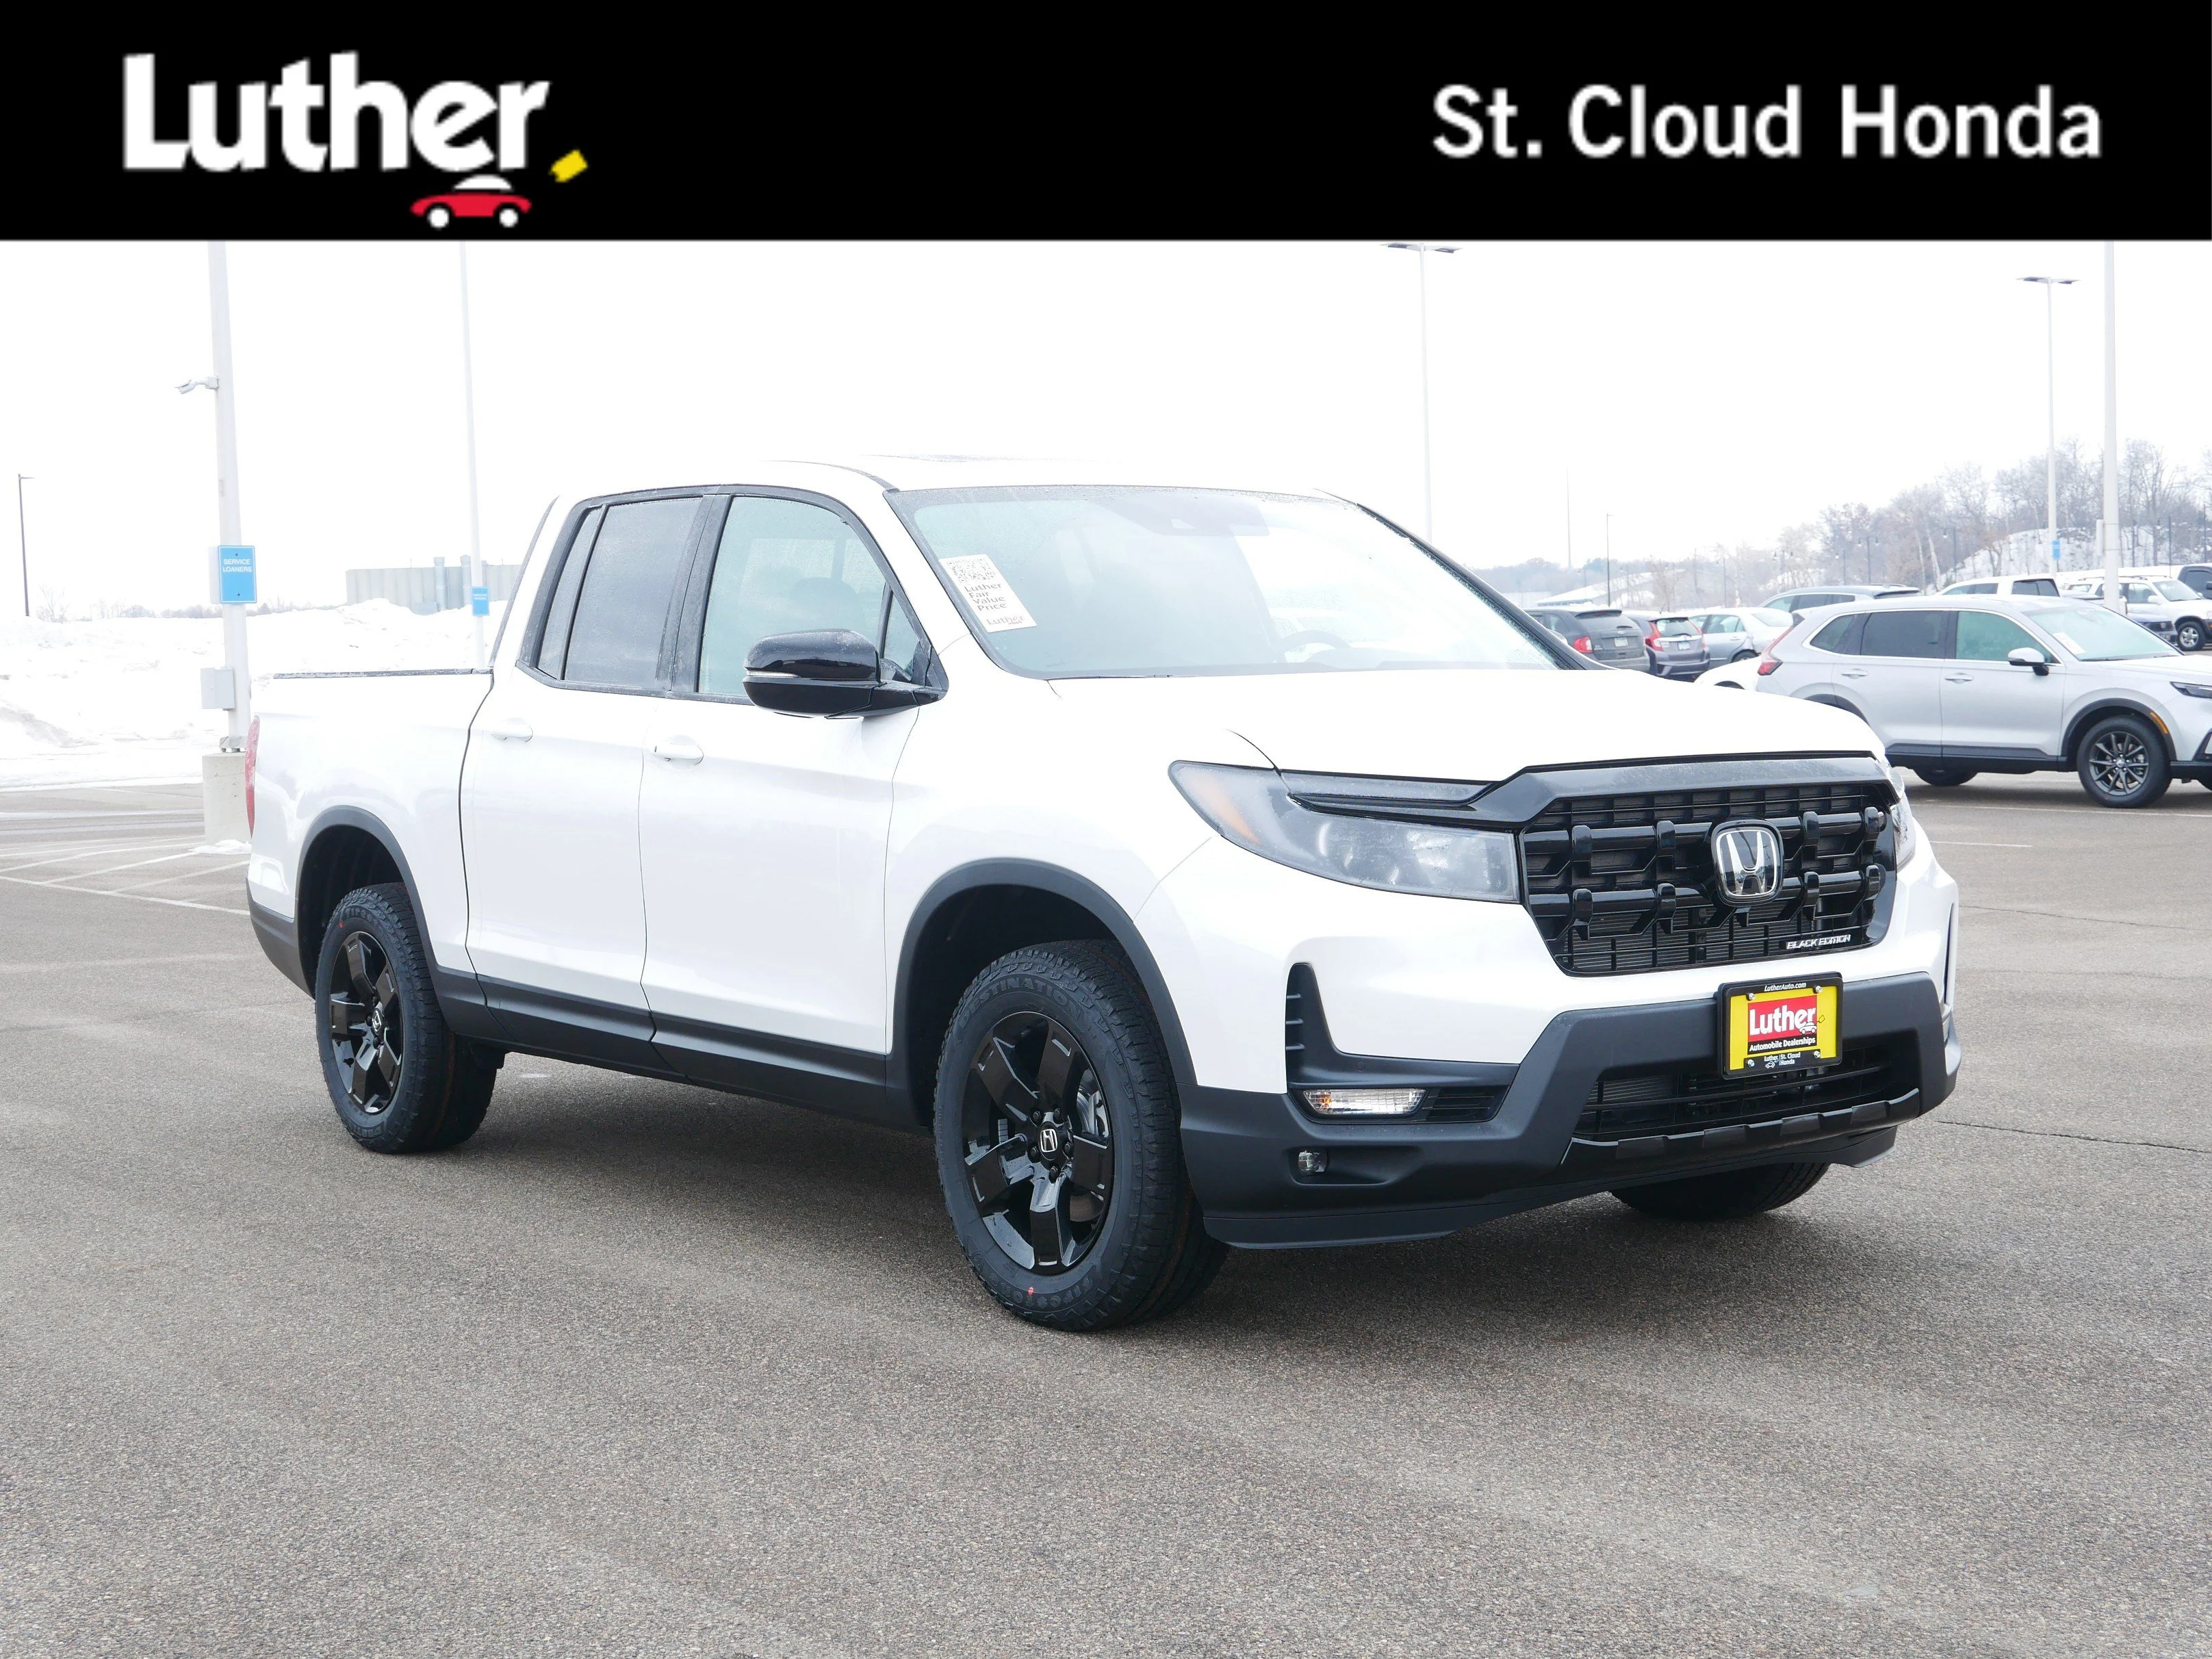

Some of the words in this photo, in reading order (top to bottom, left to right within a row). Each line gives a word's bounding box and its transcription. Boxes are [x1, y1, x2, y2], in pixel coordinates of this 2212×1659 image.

[964, 582, 1002, 593] Luther
[968, 591, 990, 599] Fair
[972, 596, 1006, 604] Value
[977, 602, 1007, 611] Price
[986, 616, 1025, 626] Luther
[1786, 938, 1818, 949] BLACK
[1818, 934, 1851, 946] EDITION
[1764, 982, 1807, 992] LutherAuto.com
[1749, 1004, 1816, 1036] Luther
[1749, 1040, 1783, 1052] Automobile
[1783, 1037, 1816, 1048] Dealerships
